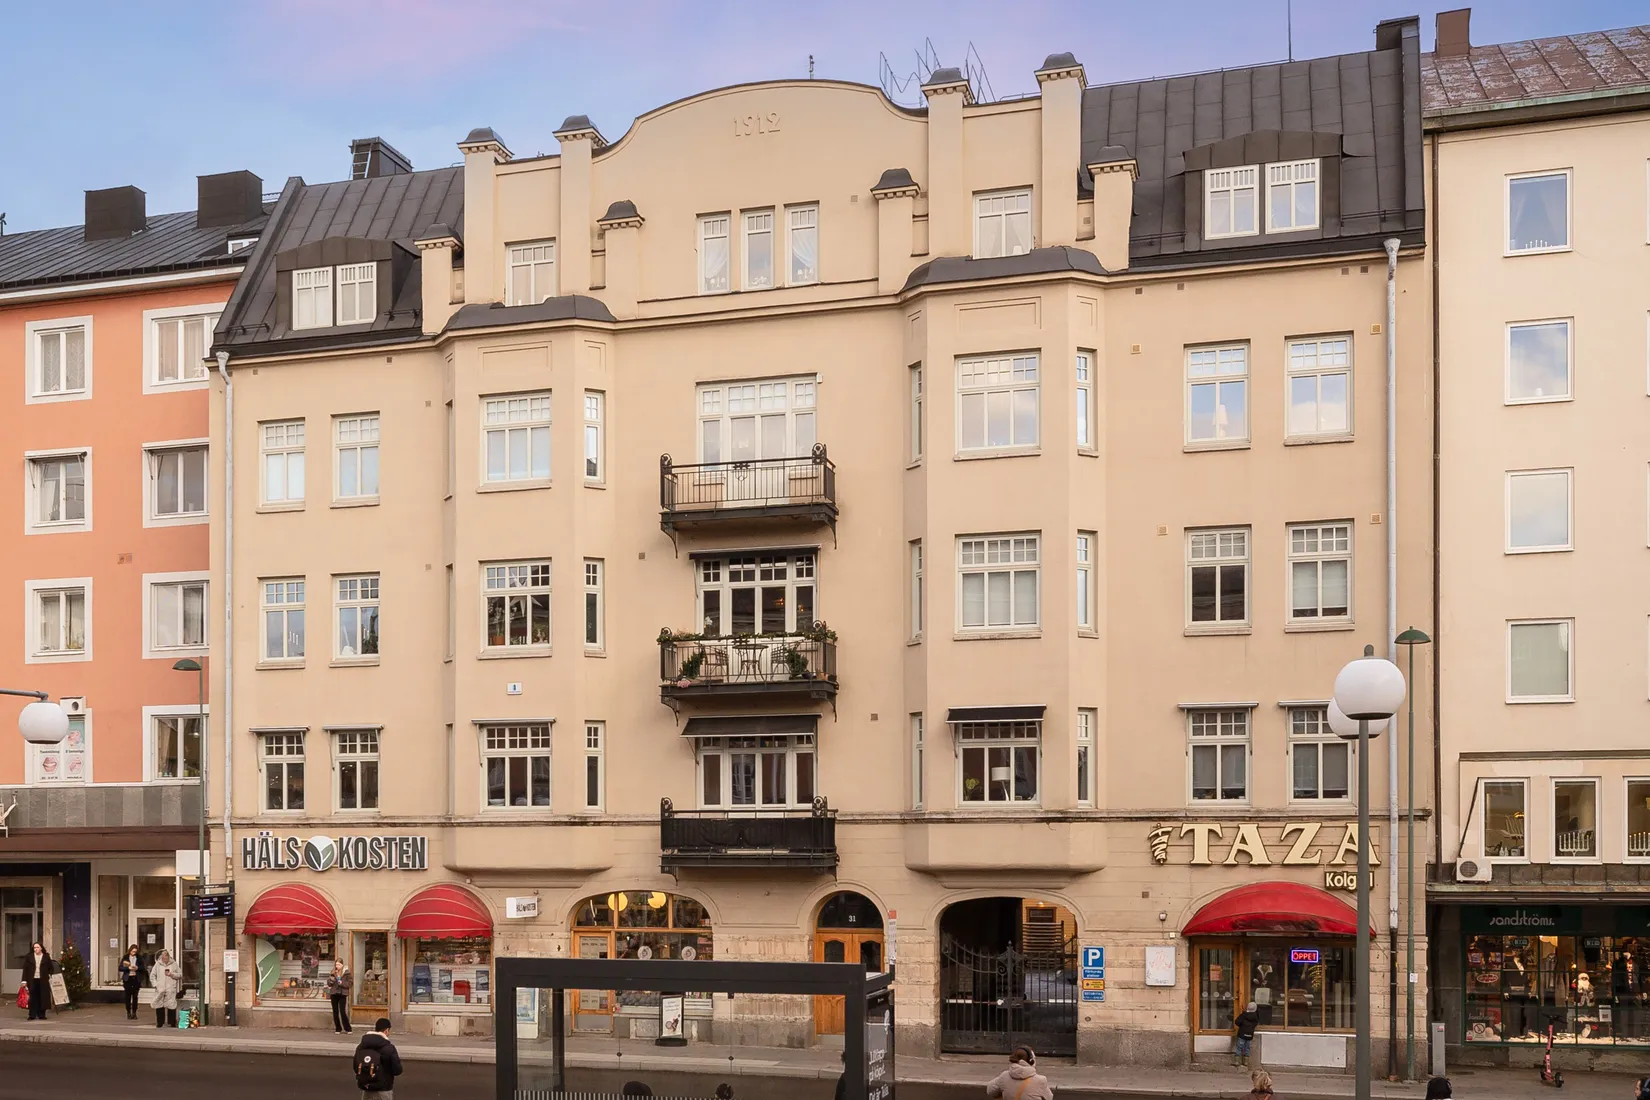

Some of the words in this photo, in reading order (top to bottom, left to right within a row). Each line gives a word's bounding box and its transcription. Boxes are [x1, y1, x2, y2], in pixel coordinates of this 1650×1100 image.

[733, 111, 781, 137] 1912
[242, 831, 302, 870] HÄLS
[338, 836, 428, 870] KOSTEN
[1180, 822, 1382, 866] TAZA
[1325, 872, 1373, 889] Kolgl
[1088, 948, 1101, 966] P
[1292, 951, 1317, 961] ÖPPET
